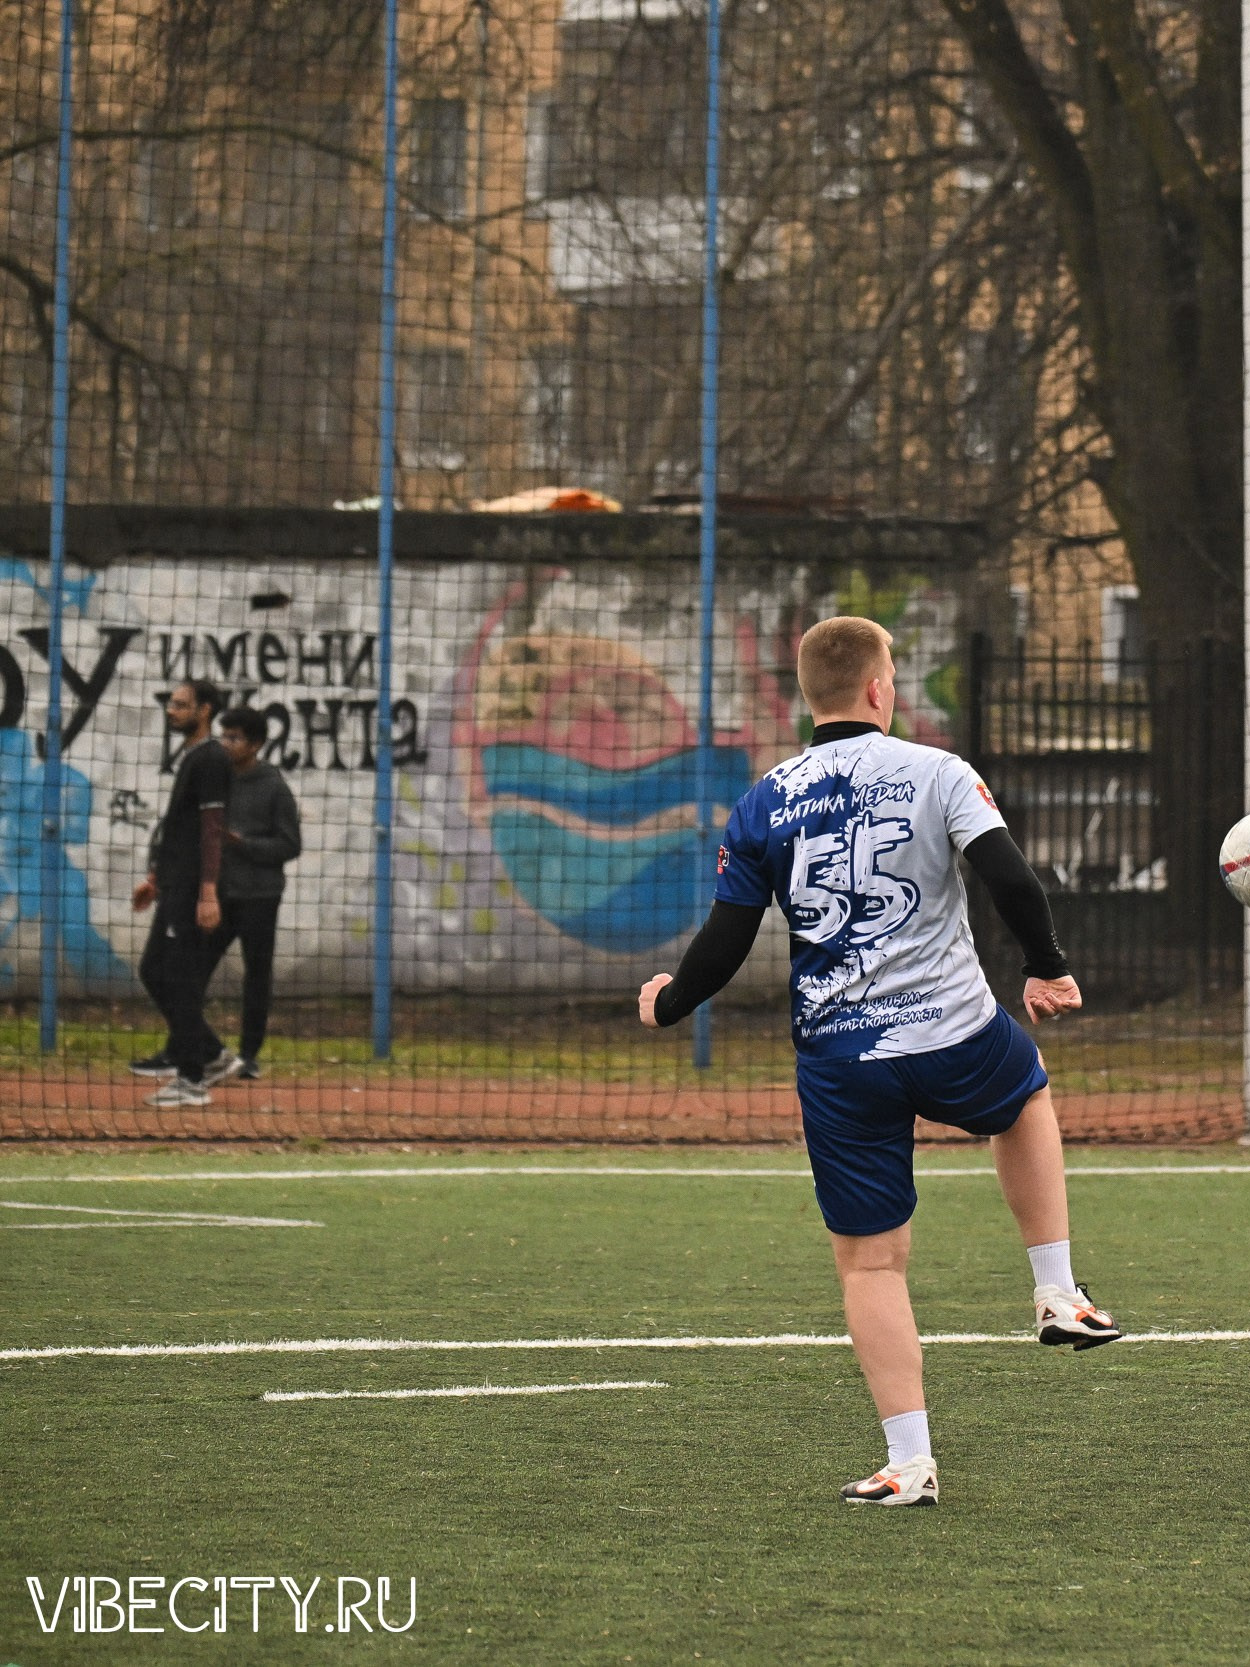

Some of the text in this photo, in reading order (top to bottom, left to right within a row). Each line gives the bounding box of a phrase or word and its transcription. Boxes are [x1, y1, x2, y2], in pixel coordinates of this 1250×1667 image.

[159, 630, 379, 685] имени
[770, 794, 846, 829] БАЛТИКА
[790, 810, 921, 945] 55
